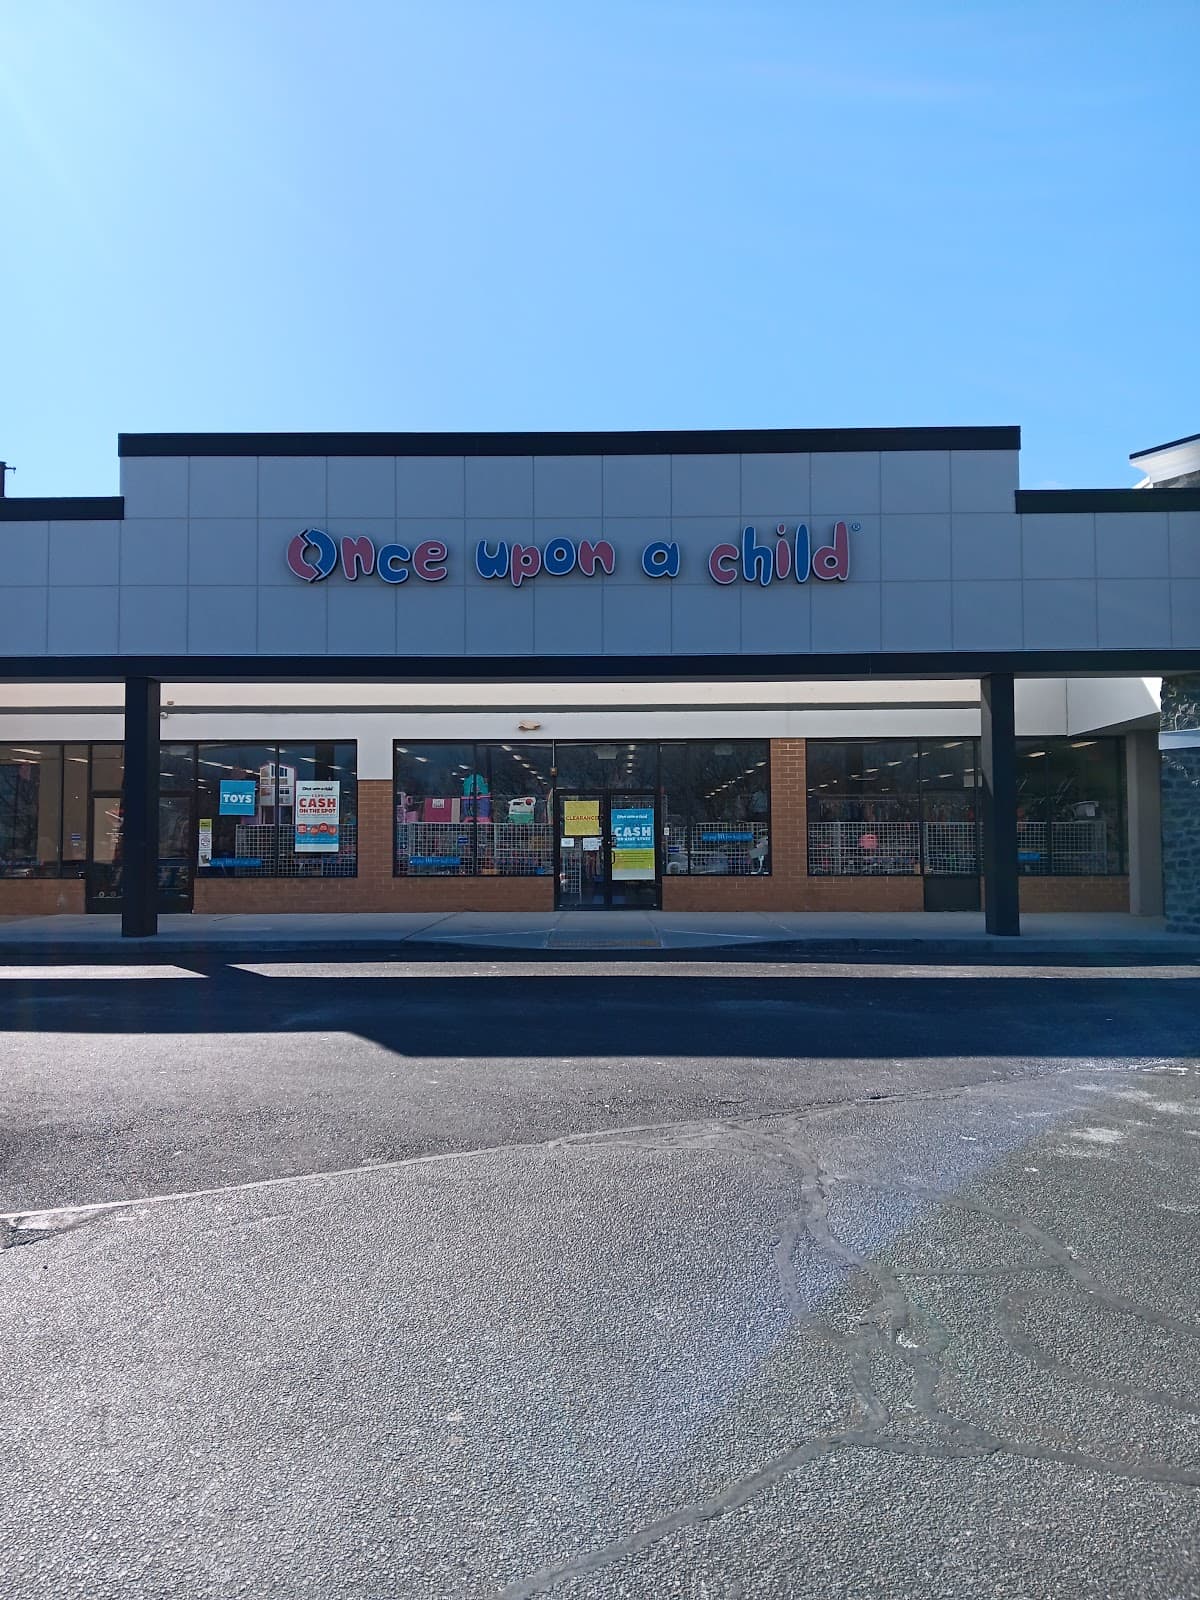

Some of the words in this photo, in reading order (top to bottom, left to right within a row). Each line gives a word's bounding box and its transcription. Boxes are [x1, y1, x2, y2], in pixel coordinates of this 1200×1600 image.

[286, 527, 448, 584] Once
[476, 538, 615, 587] upon
[642, 541, 680, 578] a
[708, 521, 851, 587] child
[223, 794, 252, 803] TOYS
[299, 798, 336, 807] CASH
[614, 826, 651, 836] CASH
